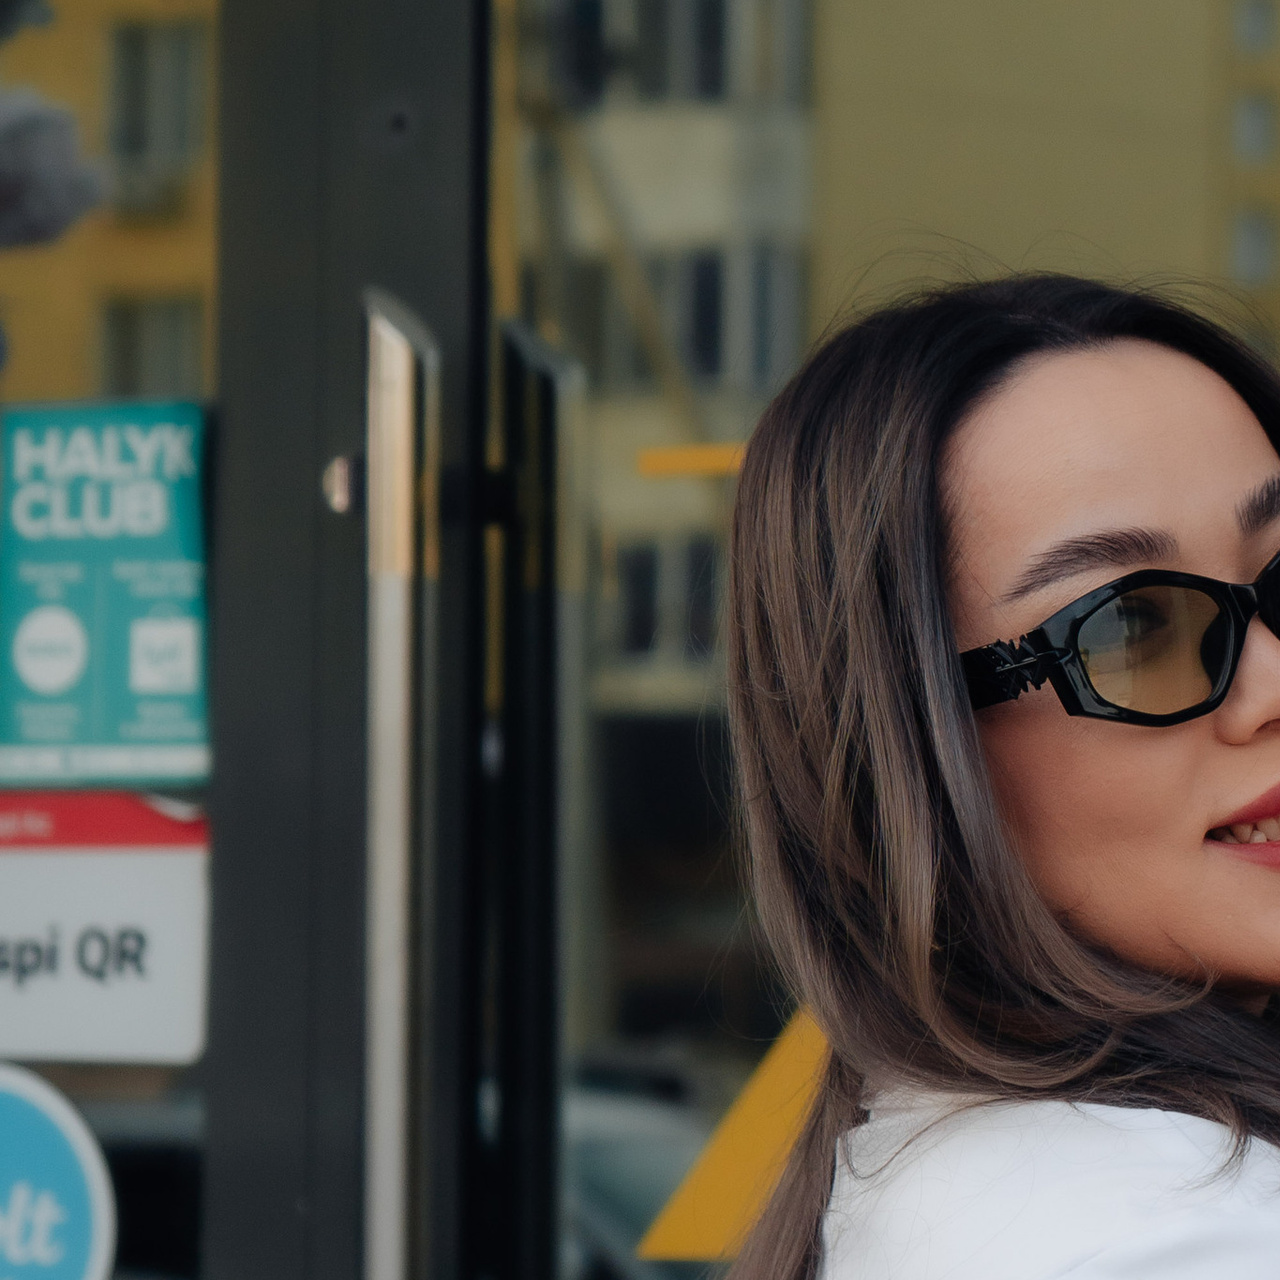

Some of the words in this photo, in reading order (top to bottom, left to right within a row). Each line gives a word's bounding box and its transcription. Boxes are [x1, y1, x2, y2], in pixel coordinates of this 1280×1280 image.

[13, 424, 195, 480] HALYK
[11, 480, 167, 540] CLUB
[75, 925, 146, 984] QR
